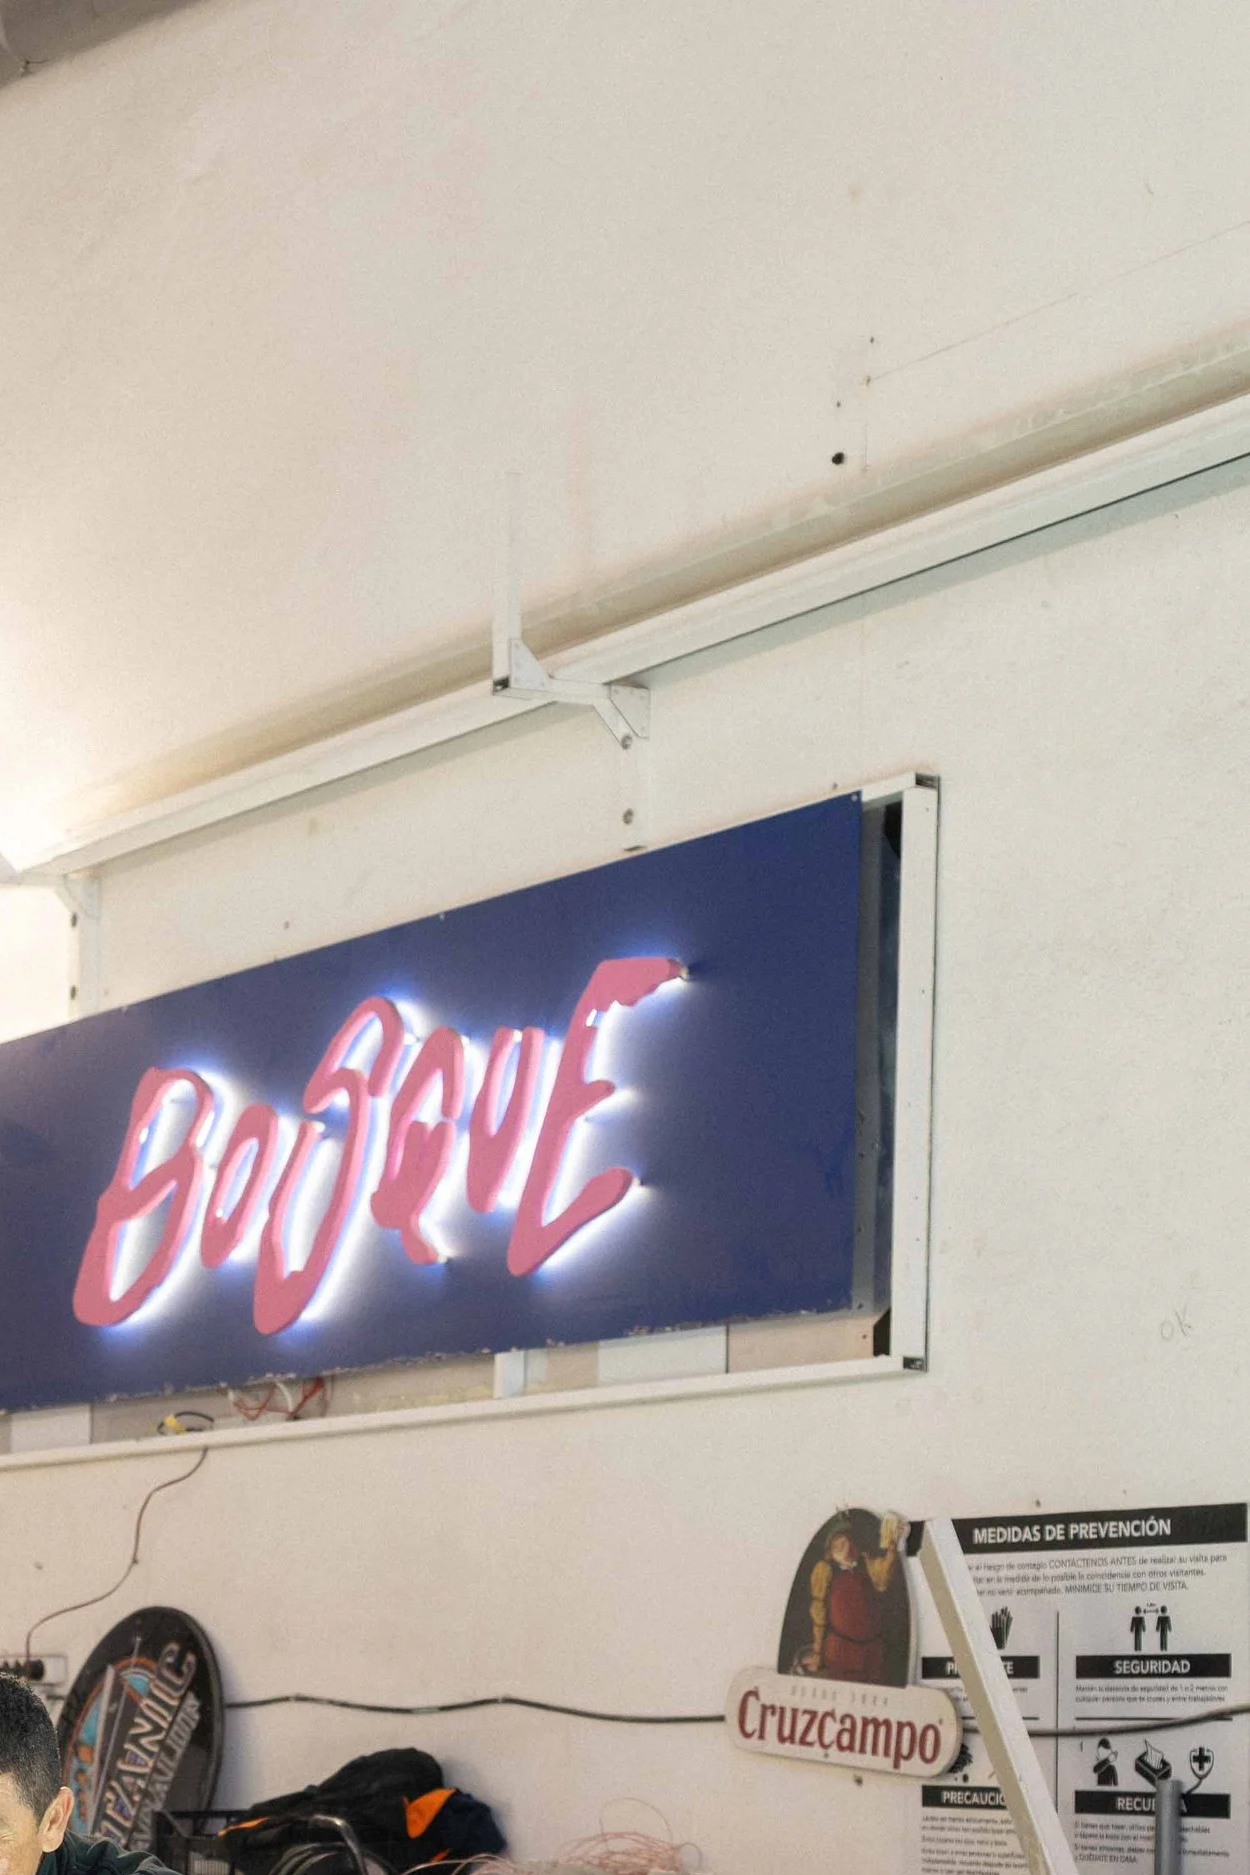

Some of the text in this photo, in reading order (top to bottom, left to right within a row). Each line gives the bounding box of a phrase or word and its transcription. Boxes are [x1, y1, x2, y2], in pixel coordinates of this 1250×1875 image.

[973, 1516, 1172, 1544] MEDIDAS DE PREVENCIÓN
[1114, 1659, 1191, 1675] SEGURIDAD
[737, 1686, 942, 1770] Cruzcampo
[942, 1790, 1006, 1806] PRECAUCI
